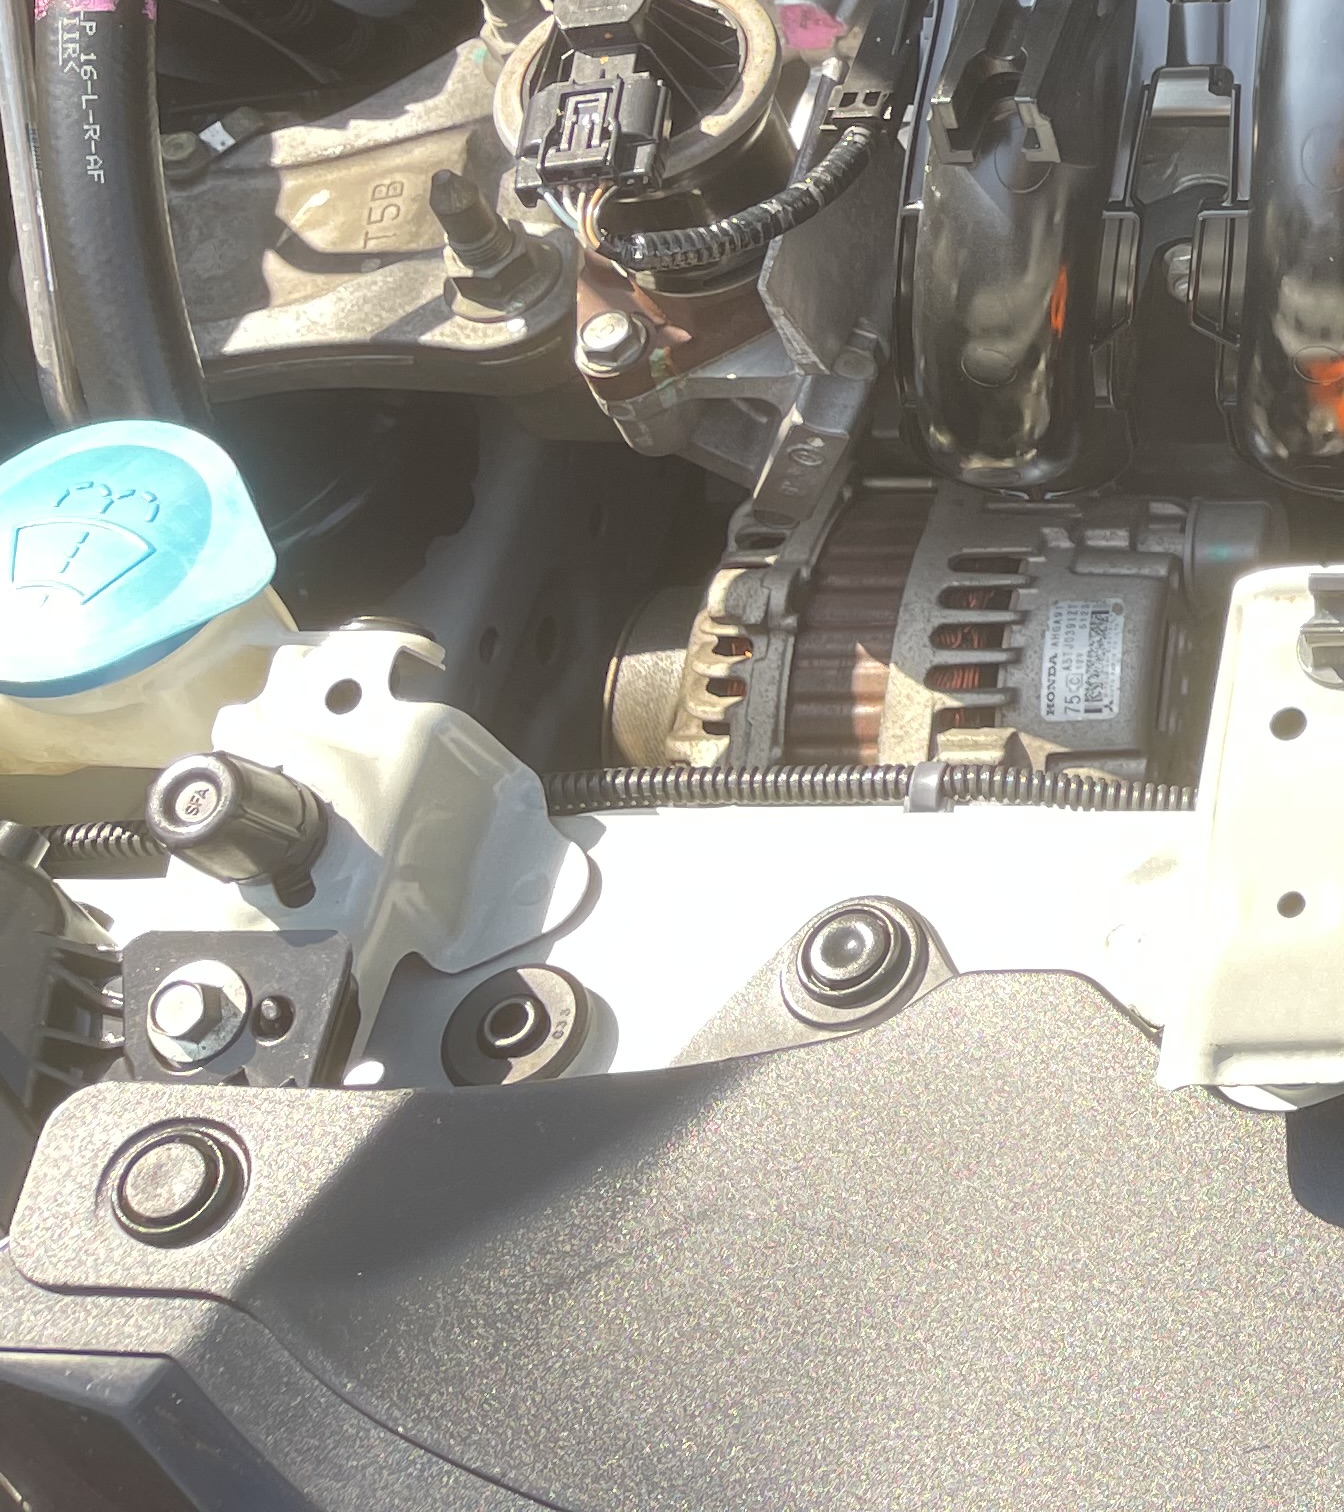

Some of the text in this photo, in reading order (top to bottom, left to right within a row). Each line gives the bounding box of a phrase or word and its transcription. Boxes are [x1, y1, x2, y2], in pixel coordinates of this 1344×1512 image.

[362, 181, 404, 249] T5B
[1046, 653, 1058, 716] HONDA
[1064, 695, 1082, 715] 75
